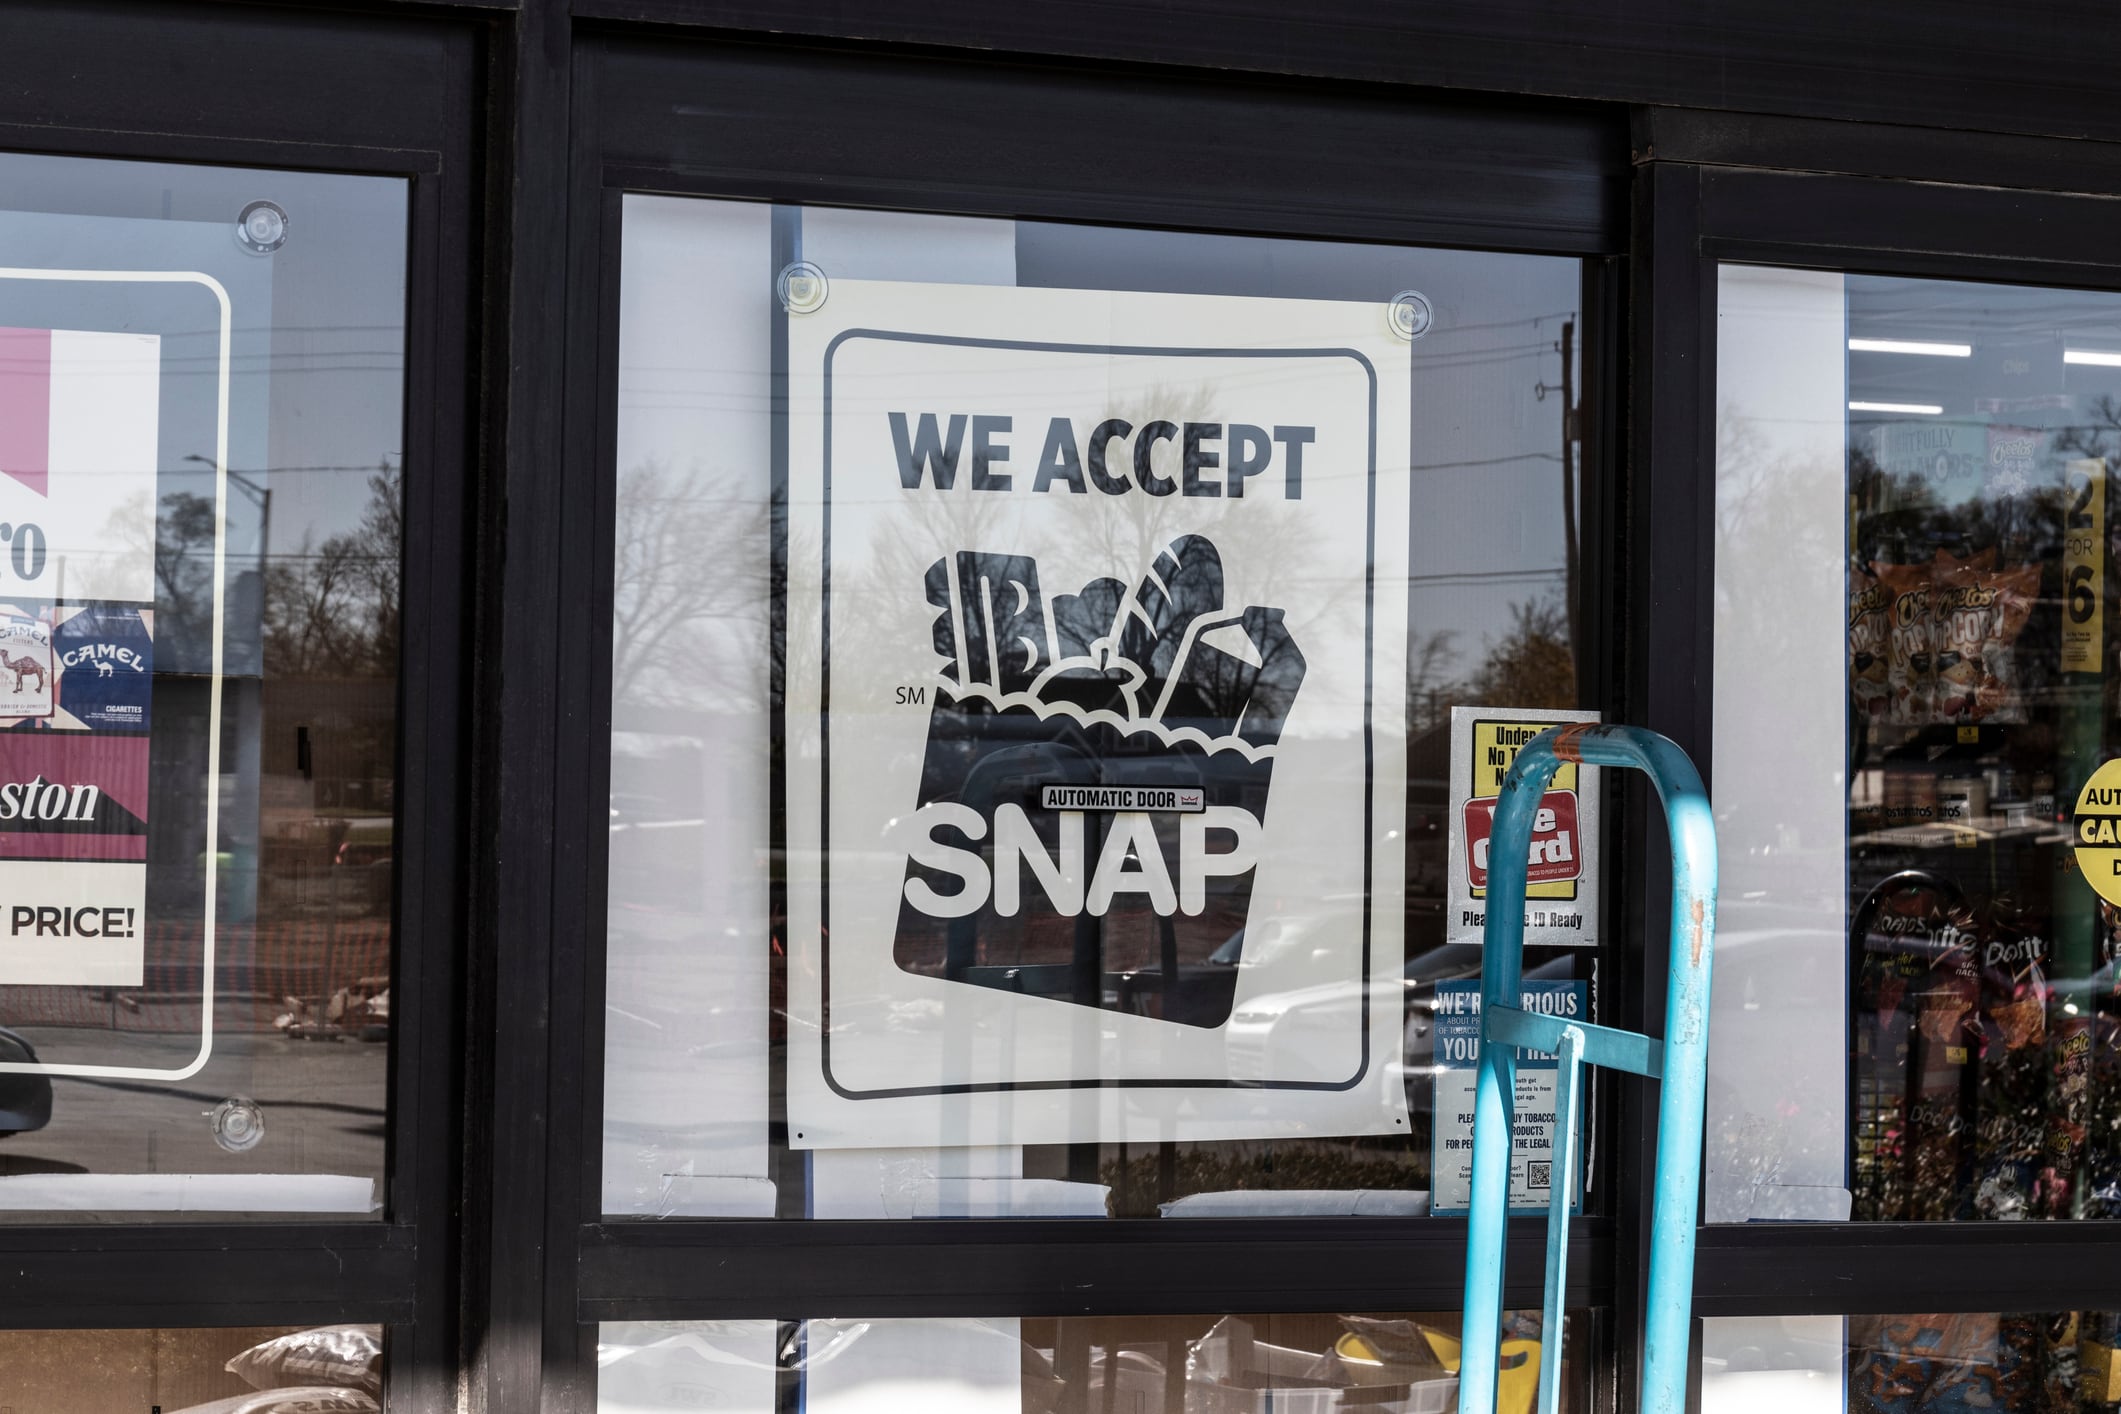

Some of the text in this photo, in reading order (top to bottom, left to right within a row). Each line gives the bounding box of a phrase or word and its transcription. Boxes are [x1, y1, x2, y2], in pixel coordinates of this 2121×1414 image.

[888, 412, 1316, 500] WE ACCEPT
[2068, 472, 2094, 529] 2
[2066, 539, 2094, 556] FOR
[0, 626, 48, 646] CAMEL
[63, 644, 144, 672] CAMEL
[895, 686, 925, 705] SM
[105, 705, 142, 713] CIGARETTES
[1488, 747, 1505, 766] No
[0, 774, 99, 821] ston
[1047, 789, 1175, 808] AUTOMATIC DOOR
[2080, 819, 2121, 843] CA
[1473, 831, 1573, 869] Crd
[904, 802, 1263, 918] SNAP
[11, 906, 135, 938] PRICE!
[1463, 911, 1485, 927] Plea
[1550, 912, 1583, 930] Ready
[1985, 936, 2049, 968] Dorit
[1438, 992, 1578, 1015] WE'R RIOUS
[1438, 1026, 1448, 1035] OF
[1447, 1017, 1469, 1025] ABOUT
[1458, 1113, 1555, 1123] PLEA UY TOBACCO
[1513, 1126, 1544, 1136] RODUCTS
[1446, 1139, 1459, 1149] FOR
[1515, 1139, 1528, 1149] THE
[1530, 1139, 1550, 1149] LEGAL
